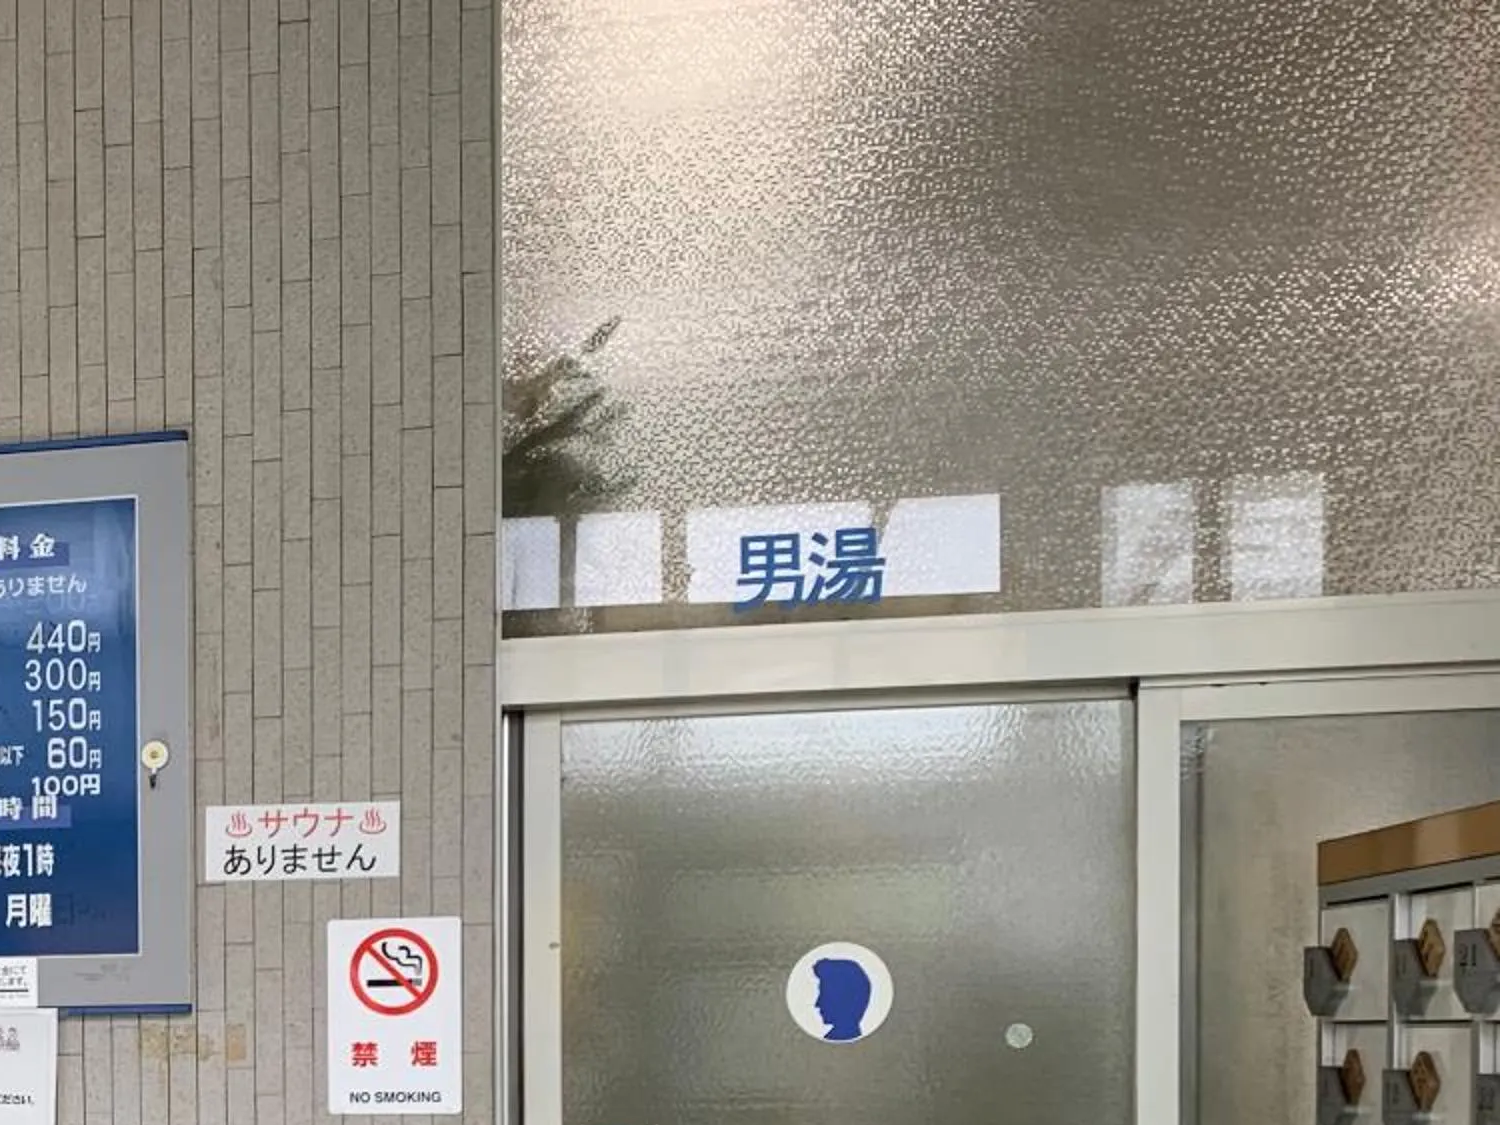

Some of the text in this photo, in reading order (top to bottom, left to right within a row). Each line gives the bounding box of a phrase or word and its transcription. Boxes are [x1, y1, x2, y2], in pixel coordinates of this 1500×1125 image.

[734, 527, 886, 613] 男湯
[26, 619, 101, 654] 440円
[24, 658, 101, 692] 300円
[32, 698, 101, 733] 150円
[46, 737, 101, 769] 60円
[31, 774, 101, 797] 100円
[258, 807, 355, 838] サウナ
[223, 844, 377, 876] ありません
[5, 893, 53, 927] 月曜
[1459, 944, 1477, 966] 21
[351, 1042, 439, 1068] 禁煙
[349, 1091, 442, 1104] NO SMOKING
